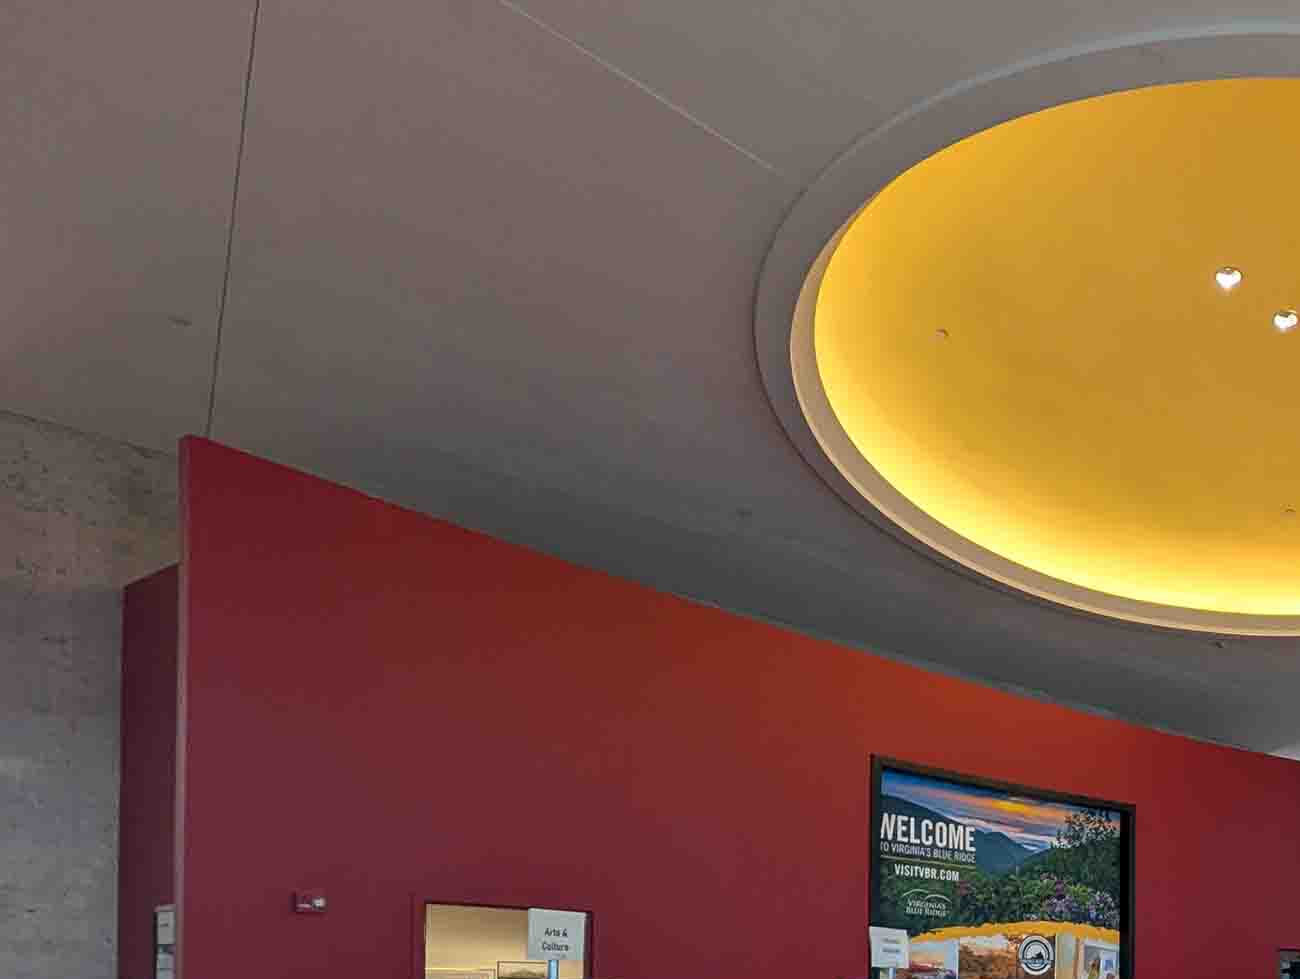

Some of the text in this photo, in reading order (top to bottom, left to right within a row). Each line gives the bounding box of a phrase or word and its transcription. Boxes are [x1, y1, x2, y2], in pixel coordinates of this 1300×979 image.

[891, 842, 931, 858] VIRGINIA'S
[933, 849, 953, 860] BLUE
[954, 851, 976, 864] RIDGE
[894, 863, 960, 881] VISITVBR.COM
[907, 897, 946, 910] VIRGINIA'S
[906, 906, 923, 916] BLUE
[544, 927, 568, 938] Arts &
[541, 941, 569, 952] Culture
